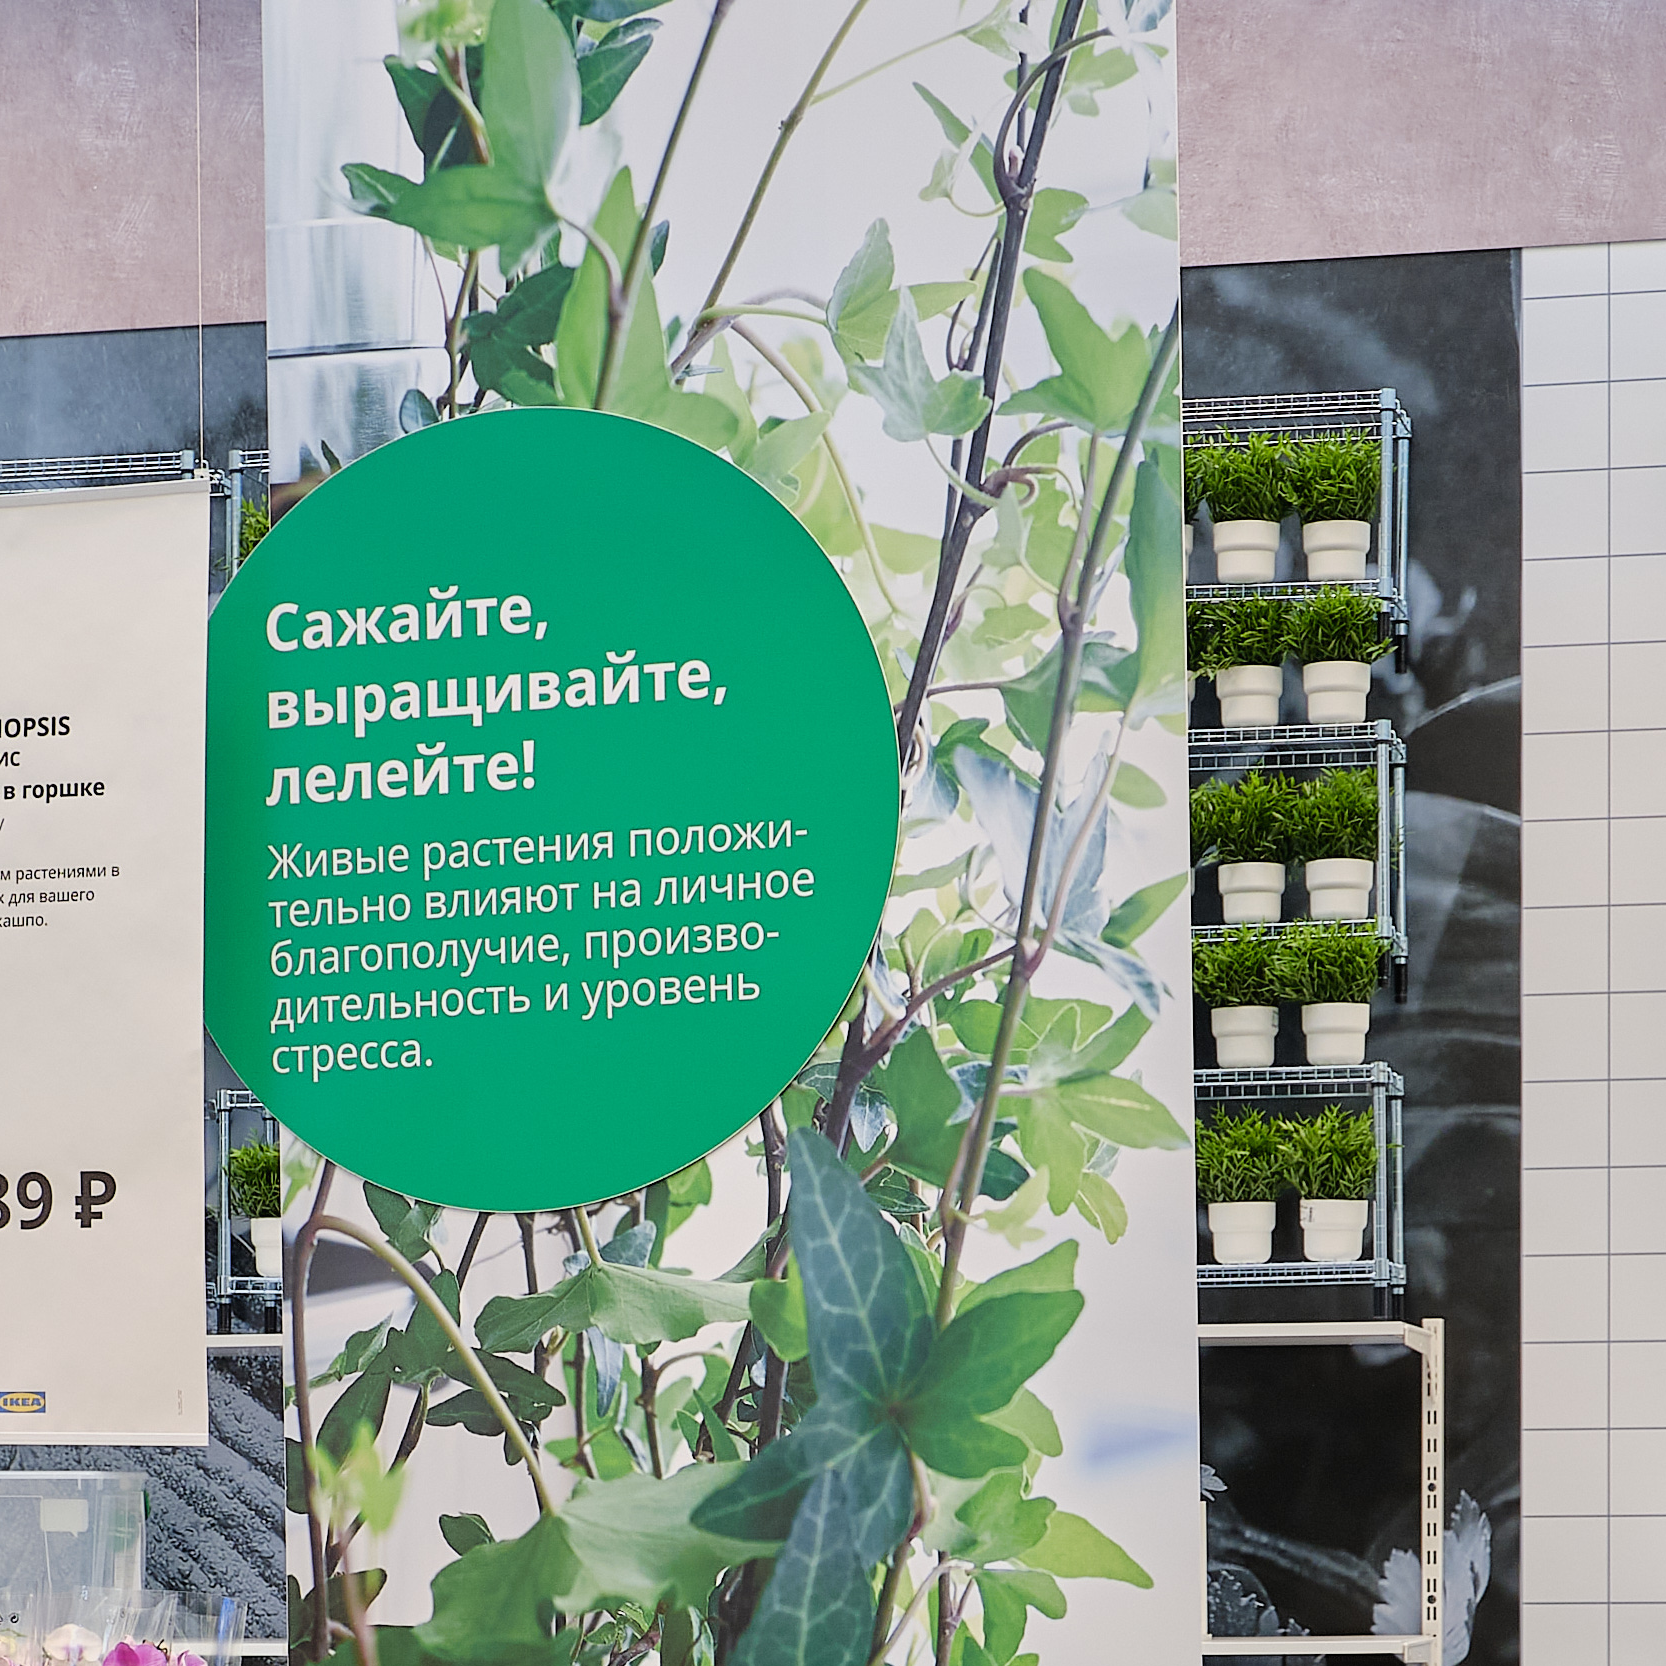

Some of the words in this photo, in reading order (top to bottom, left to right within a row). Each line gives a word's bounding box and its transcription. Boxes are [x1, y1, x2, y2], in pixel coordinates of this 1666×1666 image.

[267, 585, 547, 651] Сажайте,
[269, 650, 726, 737] выращивайте,
[4, 786, 15, 800] в
[23, 782, 104, 803] горшке
[266, 740, 534, 806] лелейте!
[16, 867, 106, 884] растениями
[268, 843, 409, 879] Живые
[424, 832, 613, 881] растения
[630, 820, 807, 857] положи-
[8, 893, 34, 907] для
[40, 891, 94, 902] вашего
[269, 894, 410, 927] тельно
[426, 883, 579, 918] влияют
[594, 880, 640, 909] на
[654, 869, 814, 905] личное
[271, 934, 569, 977] благополучие,
[586, 922, 779, 968] произво-
[271, 986, 530, 1033] дительность
[546, 983, 568, 1011] и
[582, 973, 759, 1020] уровень
[273, 1040, 432, 1082] стресса.
[75, 1171, 116, 1228] ₽
[3, 1397, 42, 1407] IKEA
